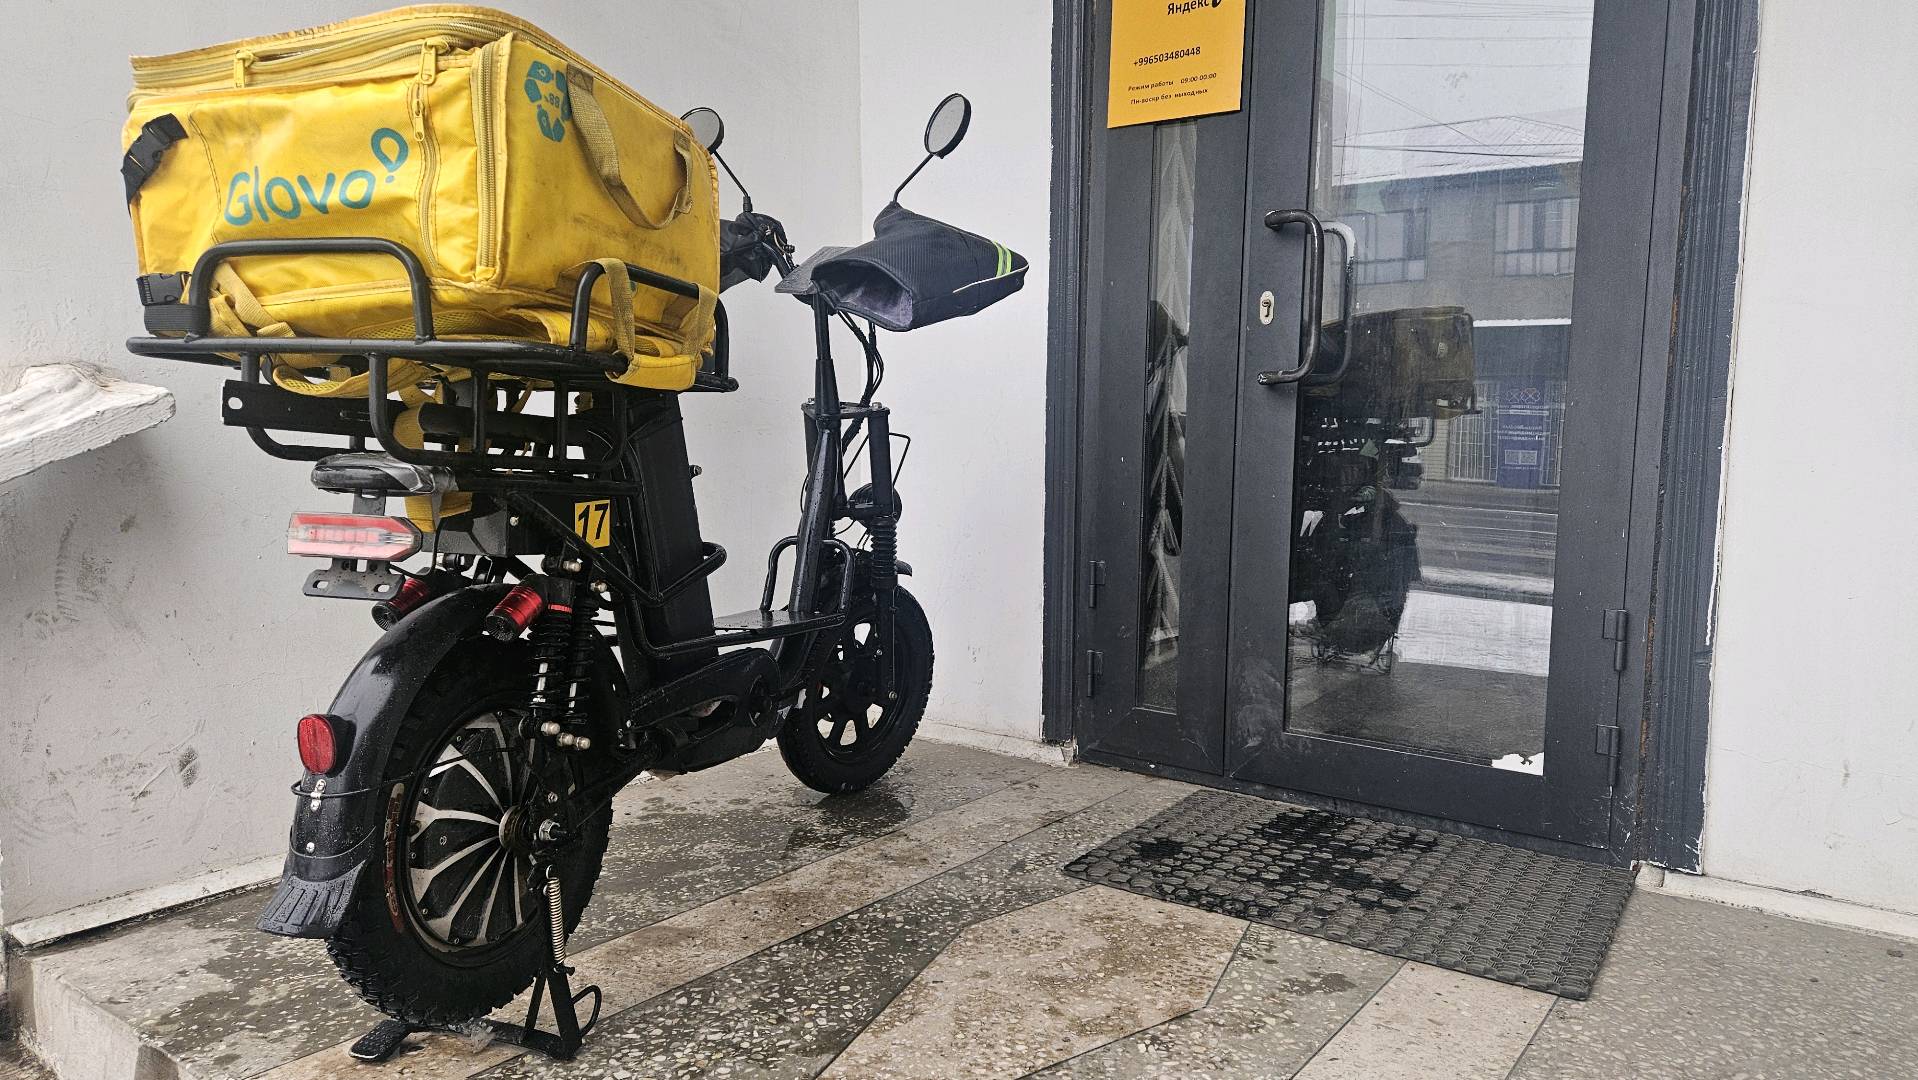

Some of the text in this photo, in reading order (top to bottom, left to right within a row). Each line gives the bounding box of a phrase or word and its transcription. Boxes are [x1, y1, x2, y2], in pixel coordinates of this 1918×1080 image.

[1167, 0, 1209, 15] Яндекс
[1133, 46, 1201, 67] +996503480448
[1128, 80, 1174, 92] Режим работы
[1174, 88, 1209, 98] выходных
[224, 165, 377, 227] Glovo
[578, 503, 609, 541] 17
